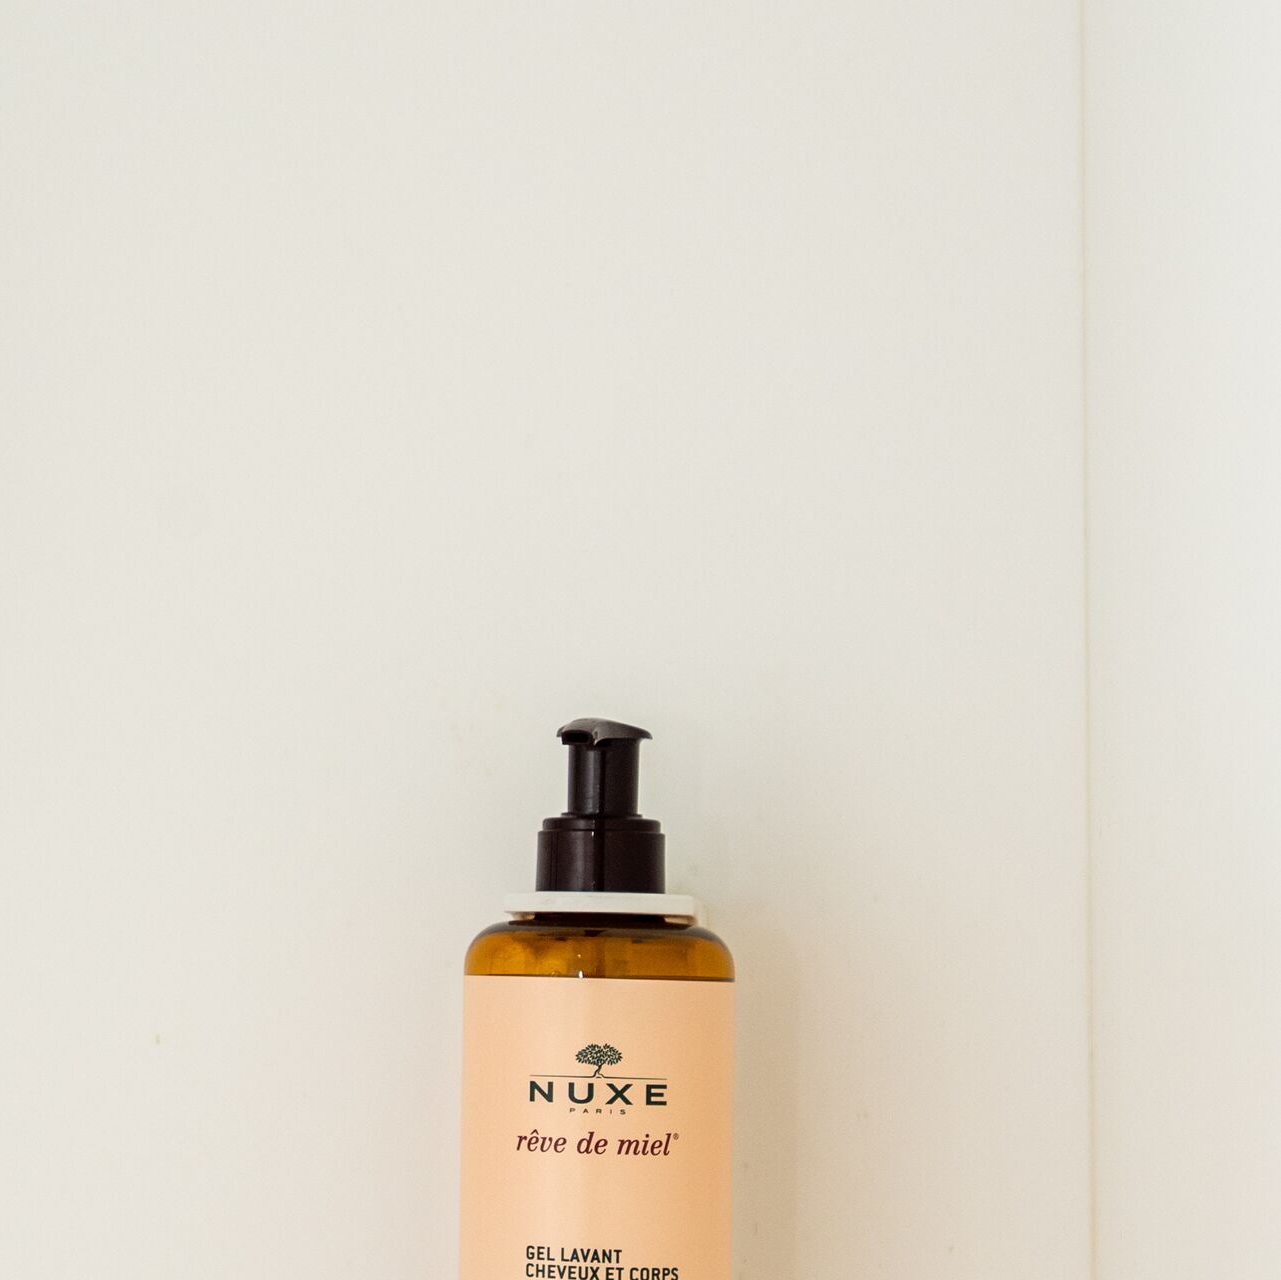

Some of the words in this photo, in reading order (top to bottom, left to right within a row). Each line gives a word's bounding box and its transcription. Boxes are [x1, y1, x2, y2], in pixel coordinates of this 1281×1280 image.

[529, 1080, 668, 1106] NUXE
[569, 1107, 626, 1115] PARIS
[516, 1129, 567, 1153] rêve
[576, 1131, 608, 1155] de
[526, 1245, 555, 1261] GEL
[560, 1247, 622, 1264] LAVANT
